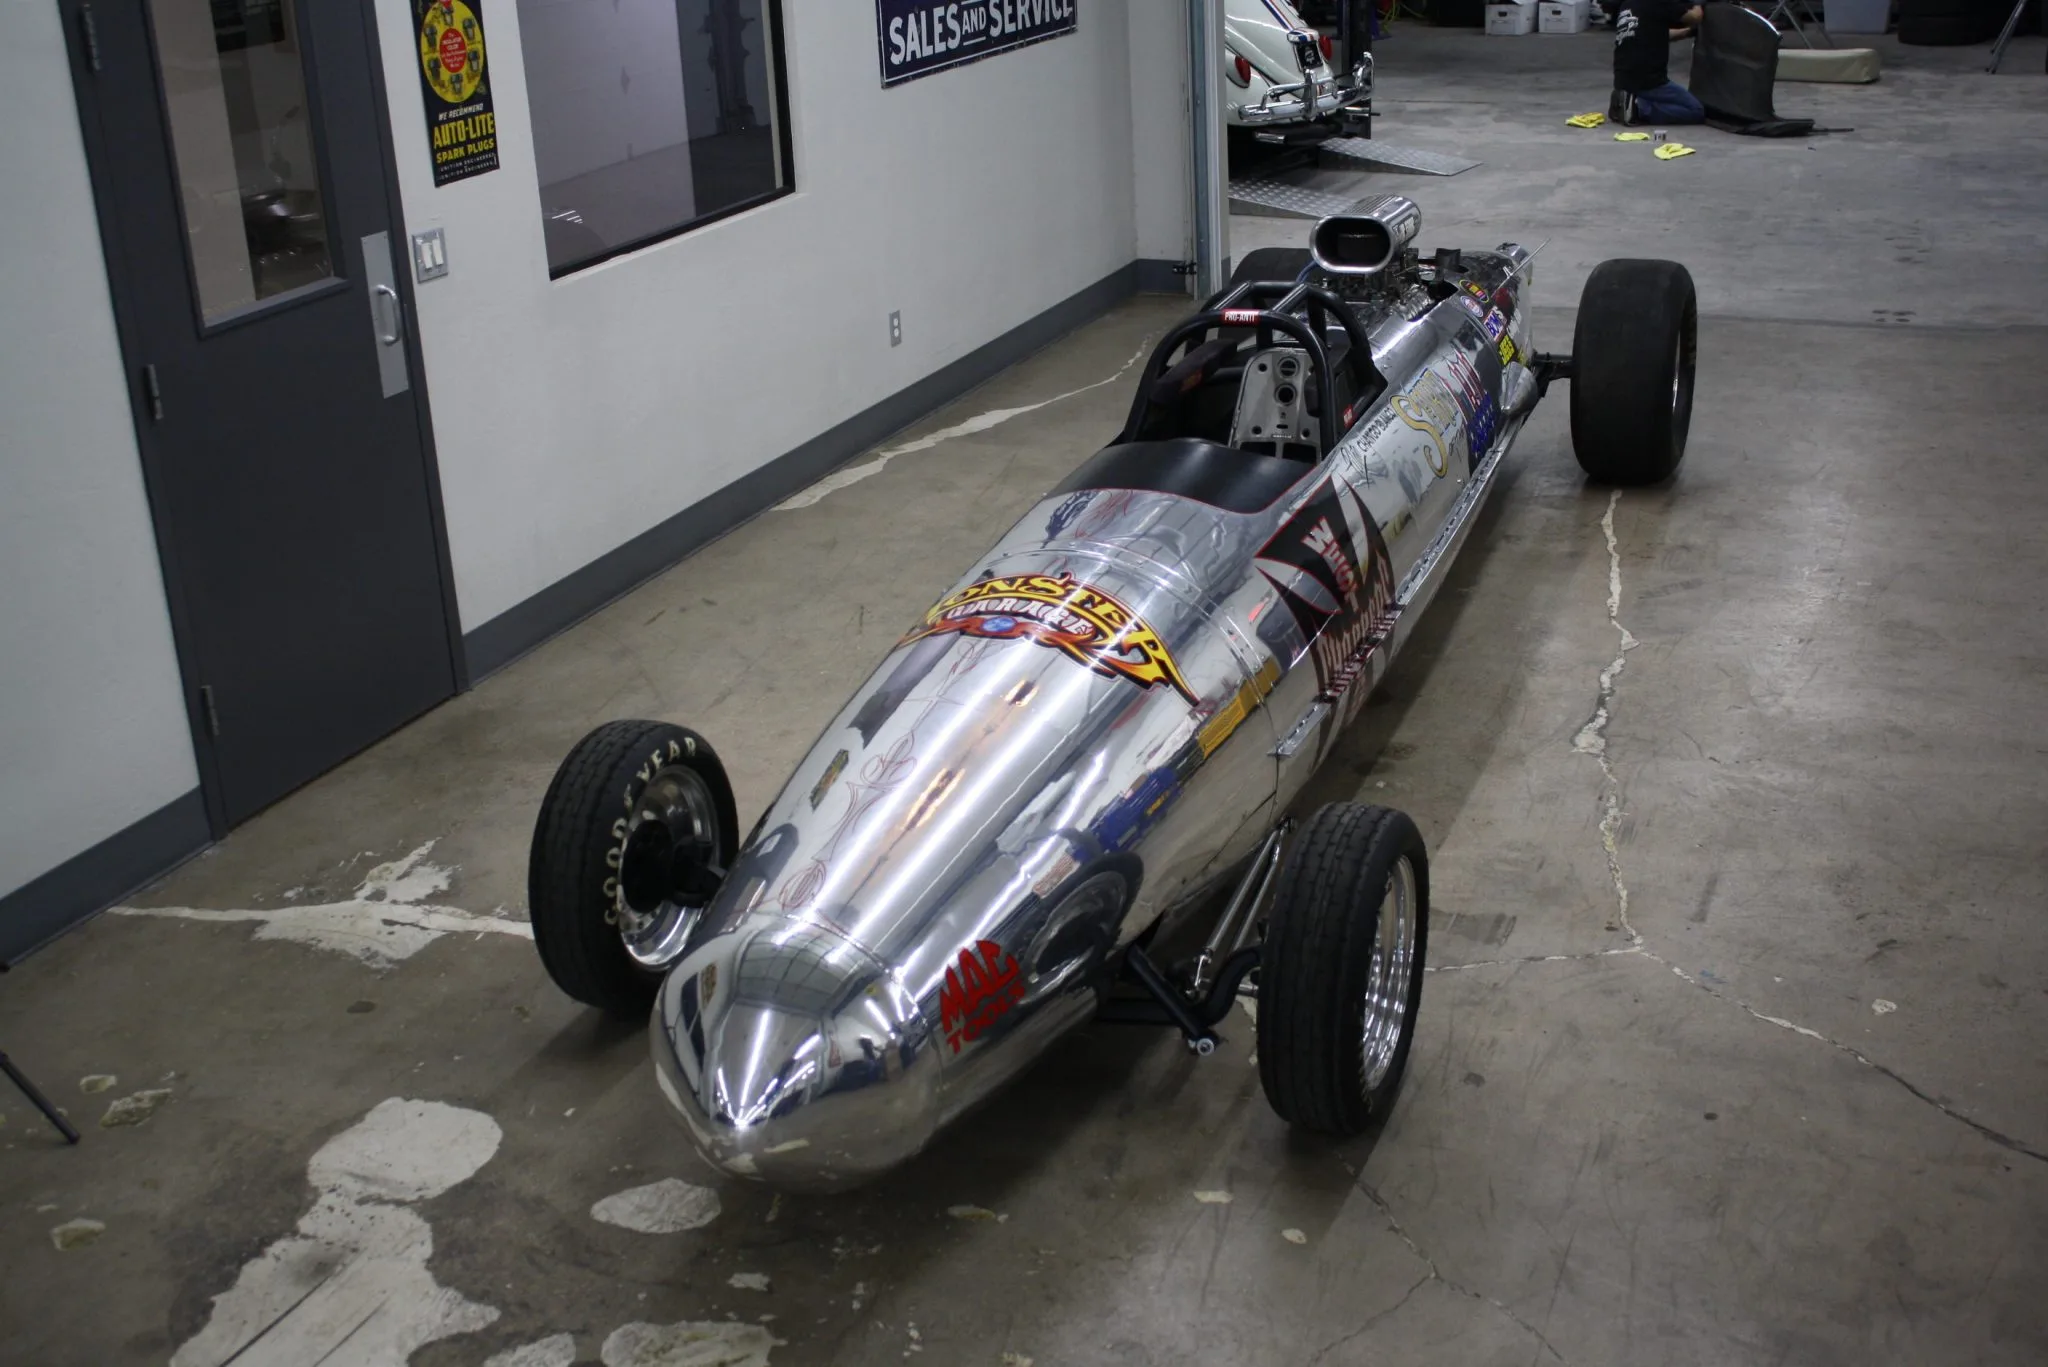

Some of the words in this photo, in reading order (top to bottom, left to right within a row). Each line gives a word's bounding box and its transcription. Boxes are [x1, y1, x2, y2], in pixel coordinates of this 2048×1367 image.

[889, 4, 962, 65] SALES
[962, 7, 986, 35] AND
[433, 113, 495, 149] AUTO-LITE
[436, 147, 466, 164] SPARK
[467, 138, 494, 156] PLUGS
[939, 939, 1019, 1034] MAC
